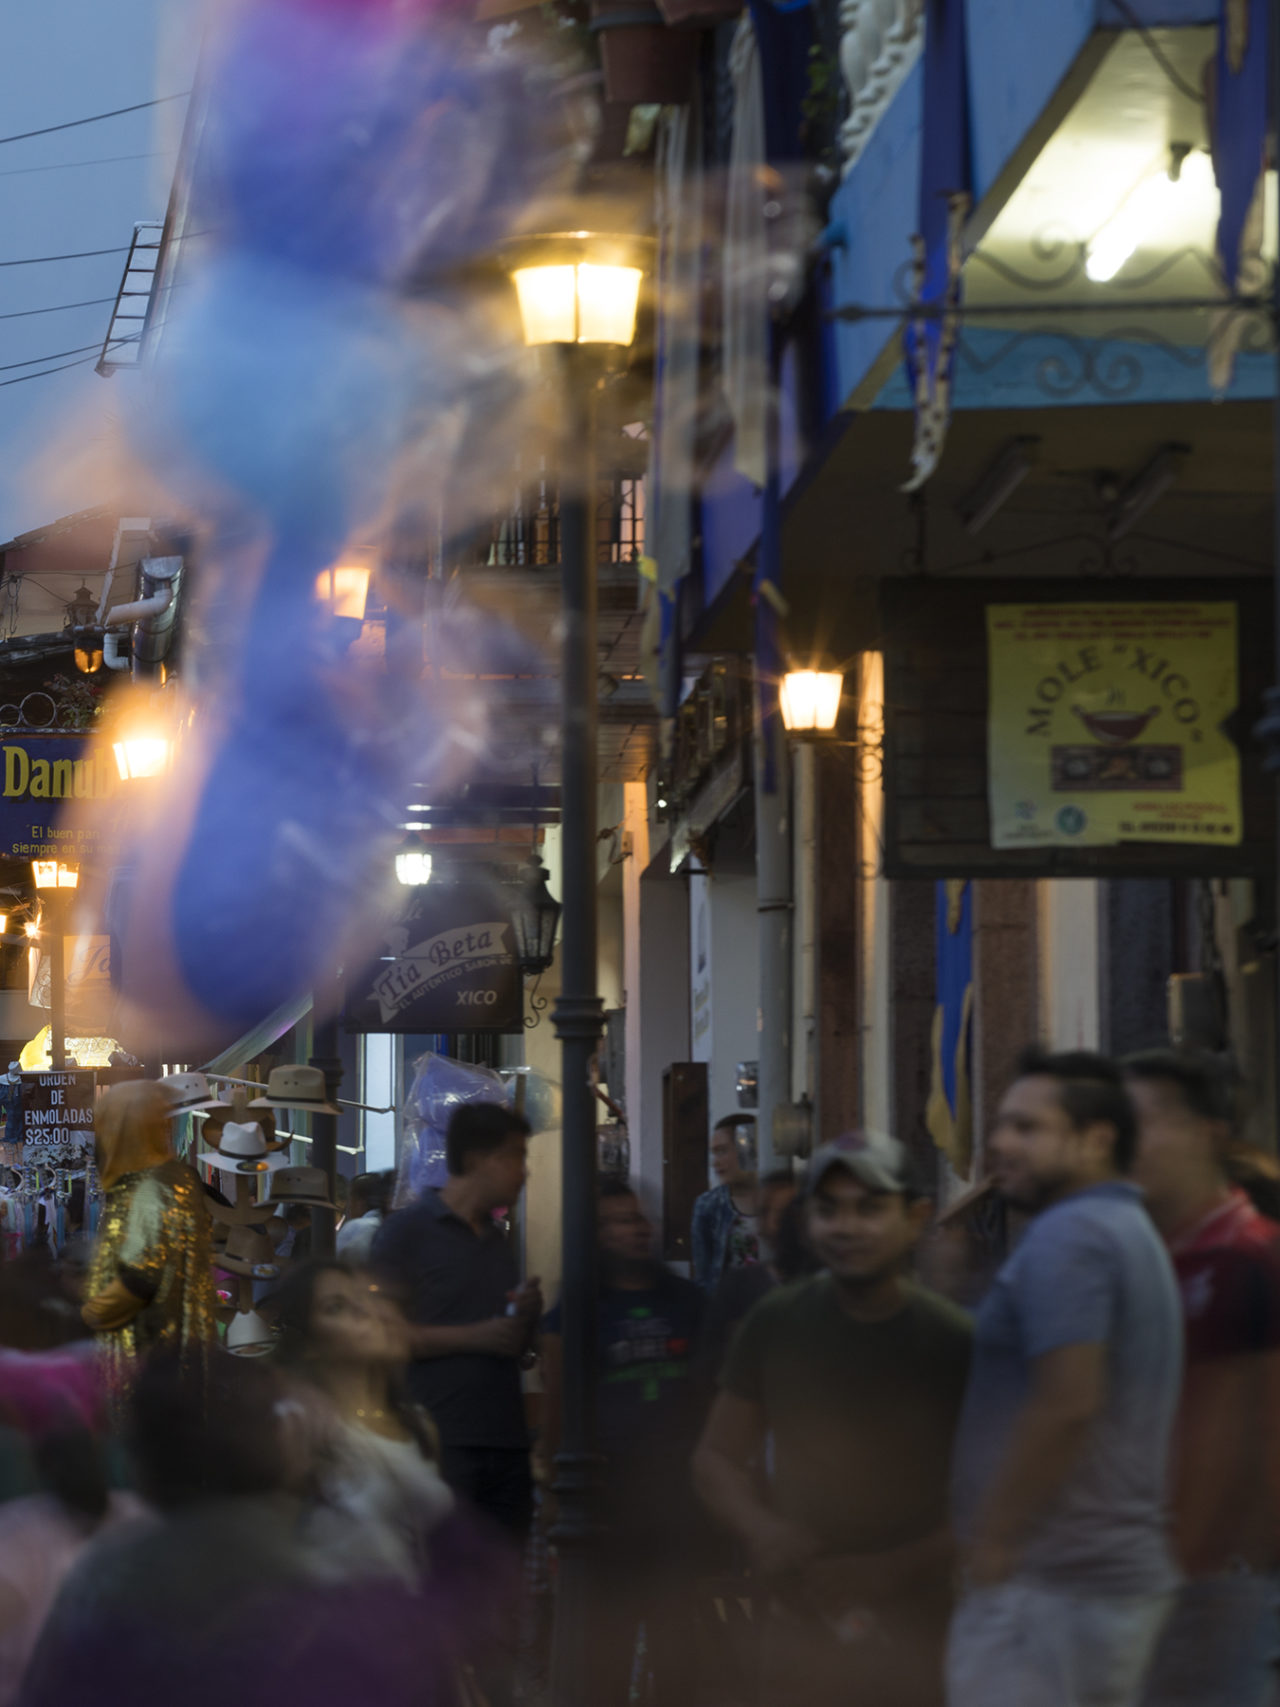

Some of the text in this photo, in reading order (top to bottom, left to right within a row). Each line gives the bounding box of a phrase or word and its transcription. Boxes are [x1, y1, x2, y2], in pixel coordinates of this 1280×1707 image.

[1024, 645, 1104, 738] MOLE
[1, 745, 119, 800] Danub
[47, 825, 74, 839] buen
[76, 829, 101, 845] pan
[11, 843, 57, 858] siempre
[62, 845, 75, 855] en
[79, 845, 94, 855] su
[429, 930, 494, 967] Beta
[455, 989, 498, 1007] XICO
[50, 1089, 65, 1106] DE
[24, 1107, 94, 1126] ENMOLADAS
